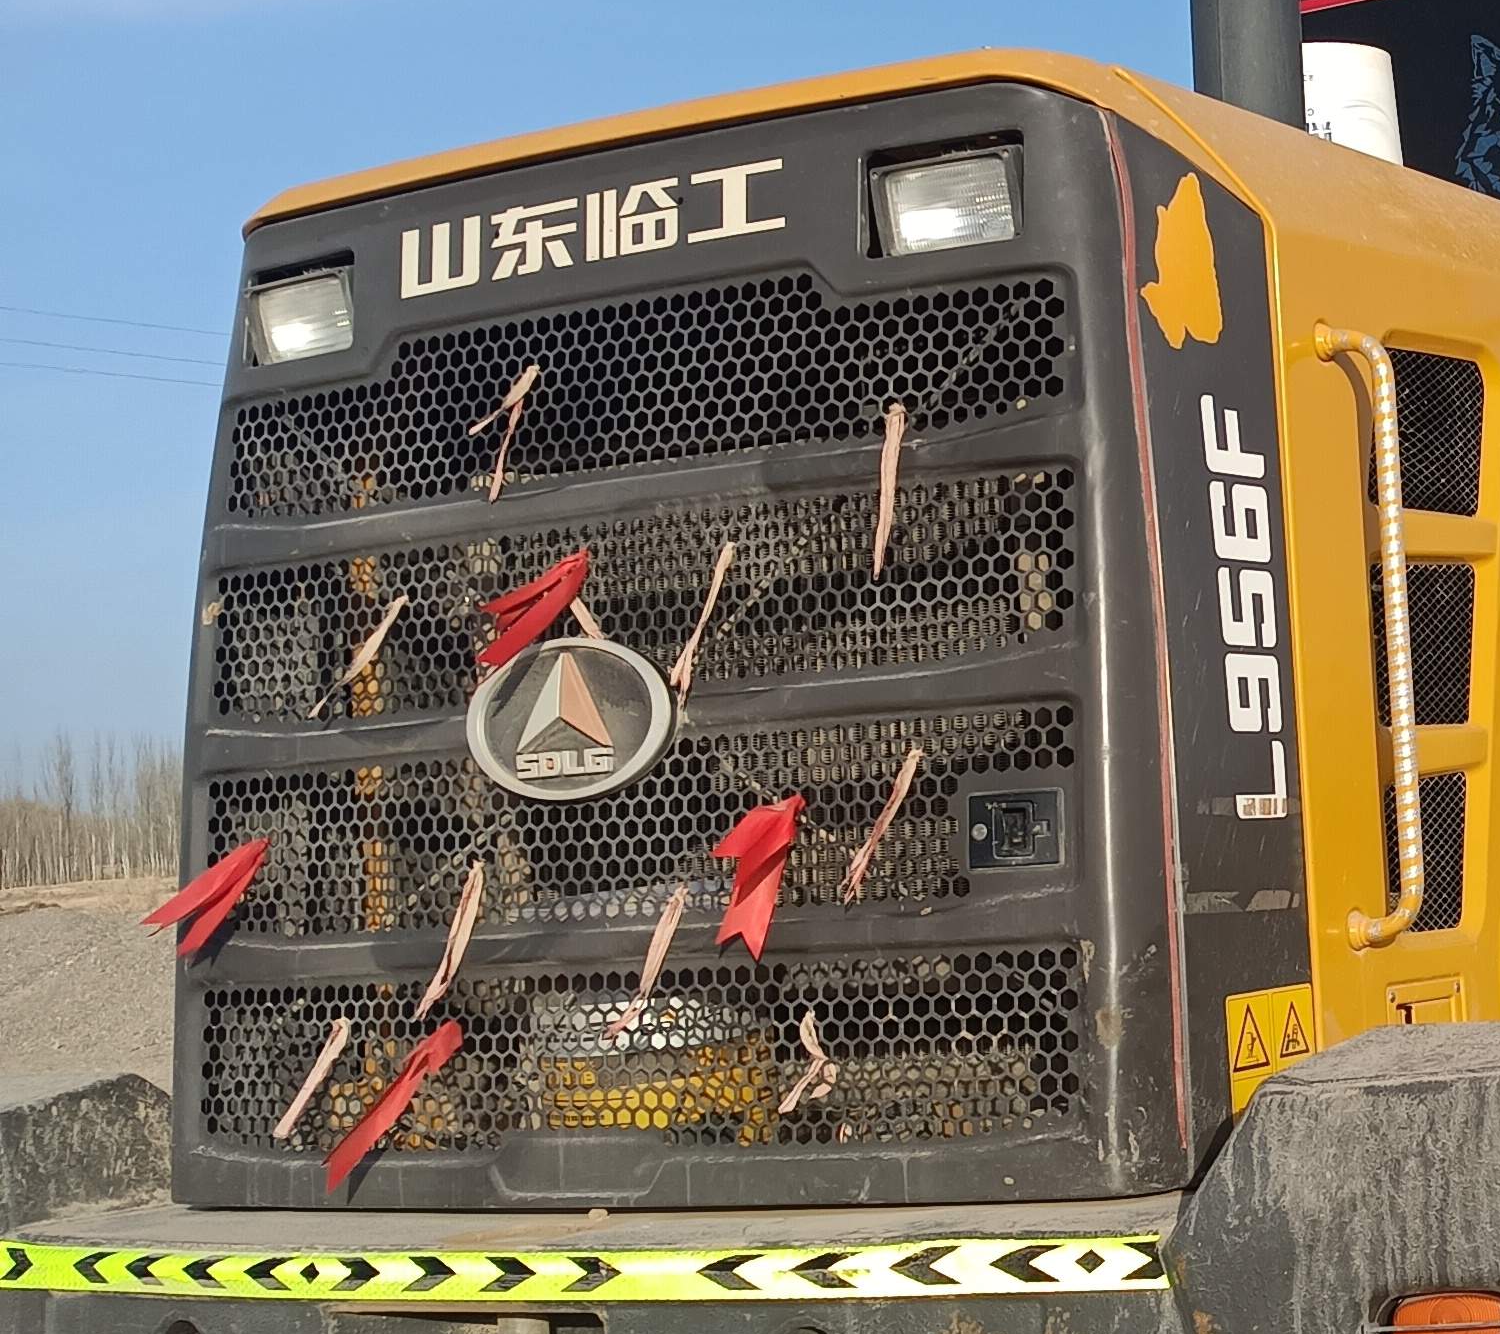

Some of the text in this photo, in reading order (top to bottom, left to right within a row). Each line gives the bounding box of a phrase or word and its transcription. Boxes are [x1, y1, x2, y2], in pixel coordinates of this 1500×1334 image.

[400, 158, 787, 300] 山东临工
[1201, 394, 1288, 820] L956F
[515, 747, 615, 780] SDLG
